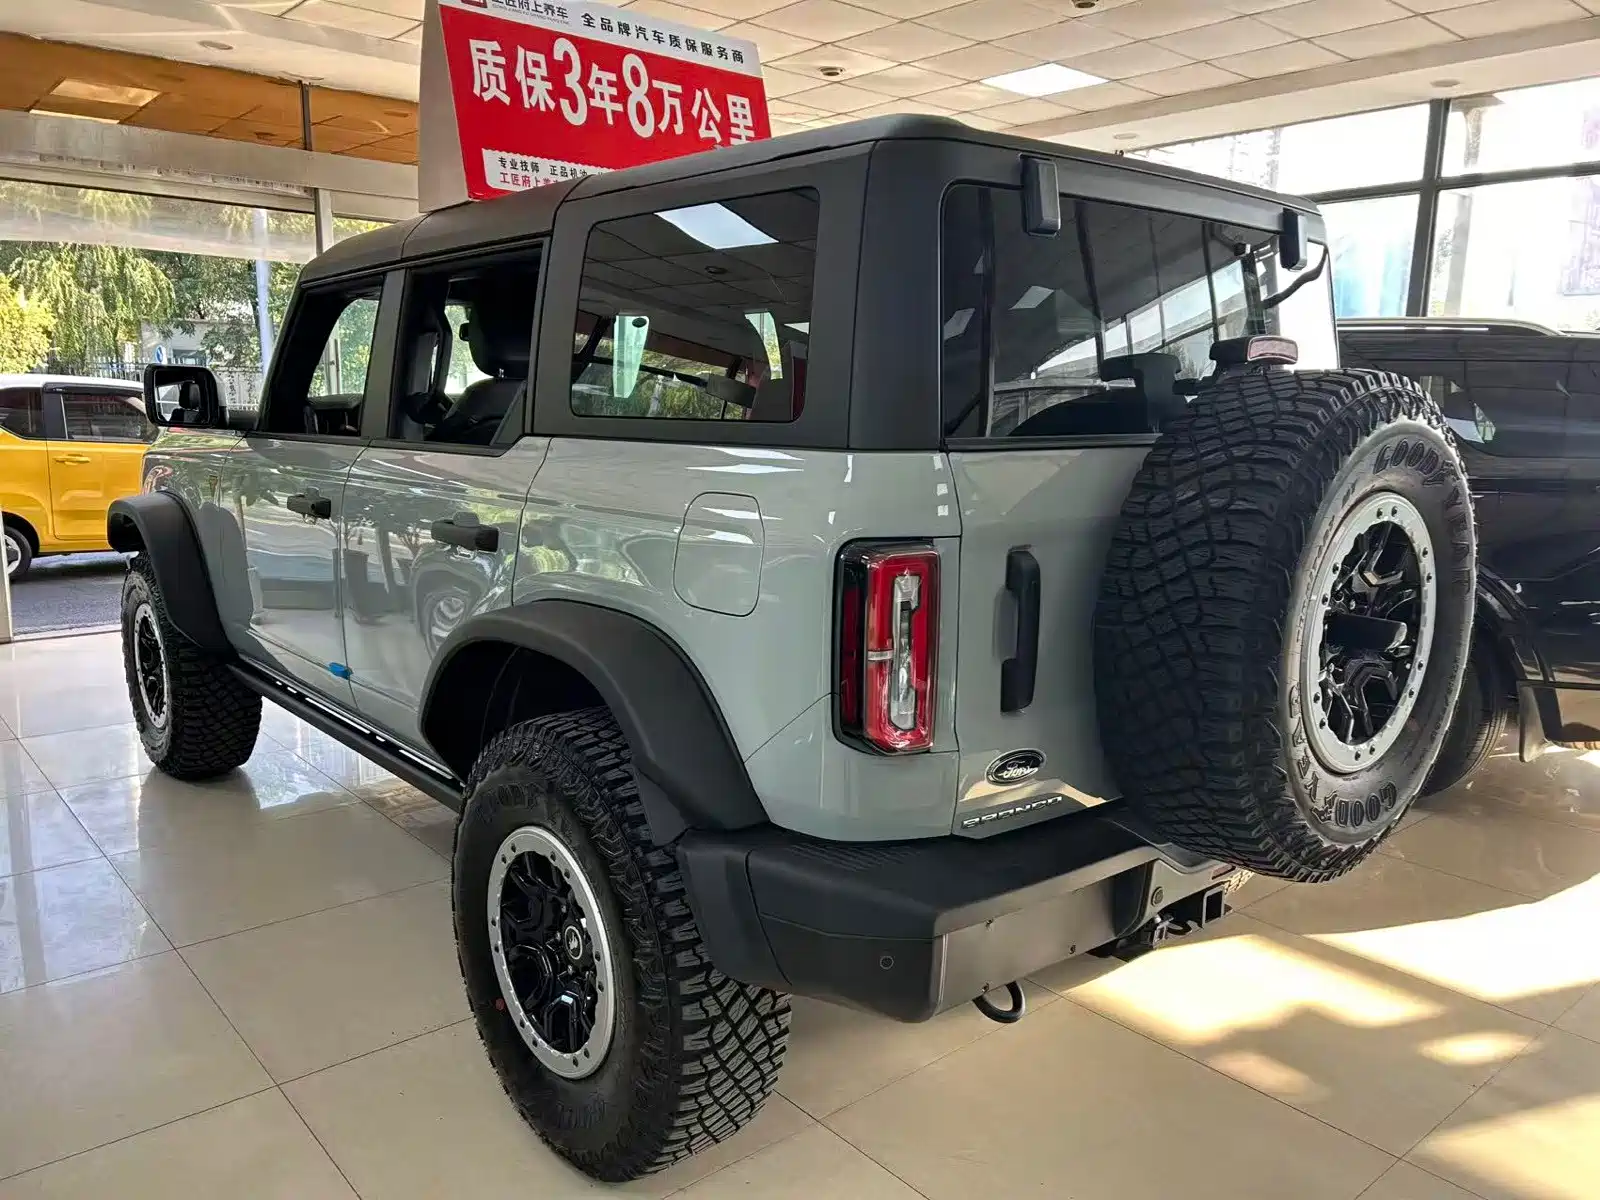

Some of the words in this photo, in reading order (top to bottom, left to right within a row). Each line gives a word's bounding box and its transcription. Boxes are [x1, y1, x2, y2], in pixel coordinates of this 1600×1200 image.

[581, 12, 746, 64] 全品牌汽车质保服务商
[468, 37, 756, 146] 质保3年8万公里
[498, 156, 540, 173] 专业技师
[998, 760, 1039, 779] Ford
